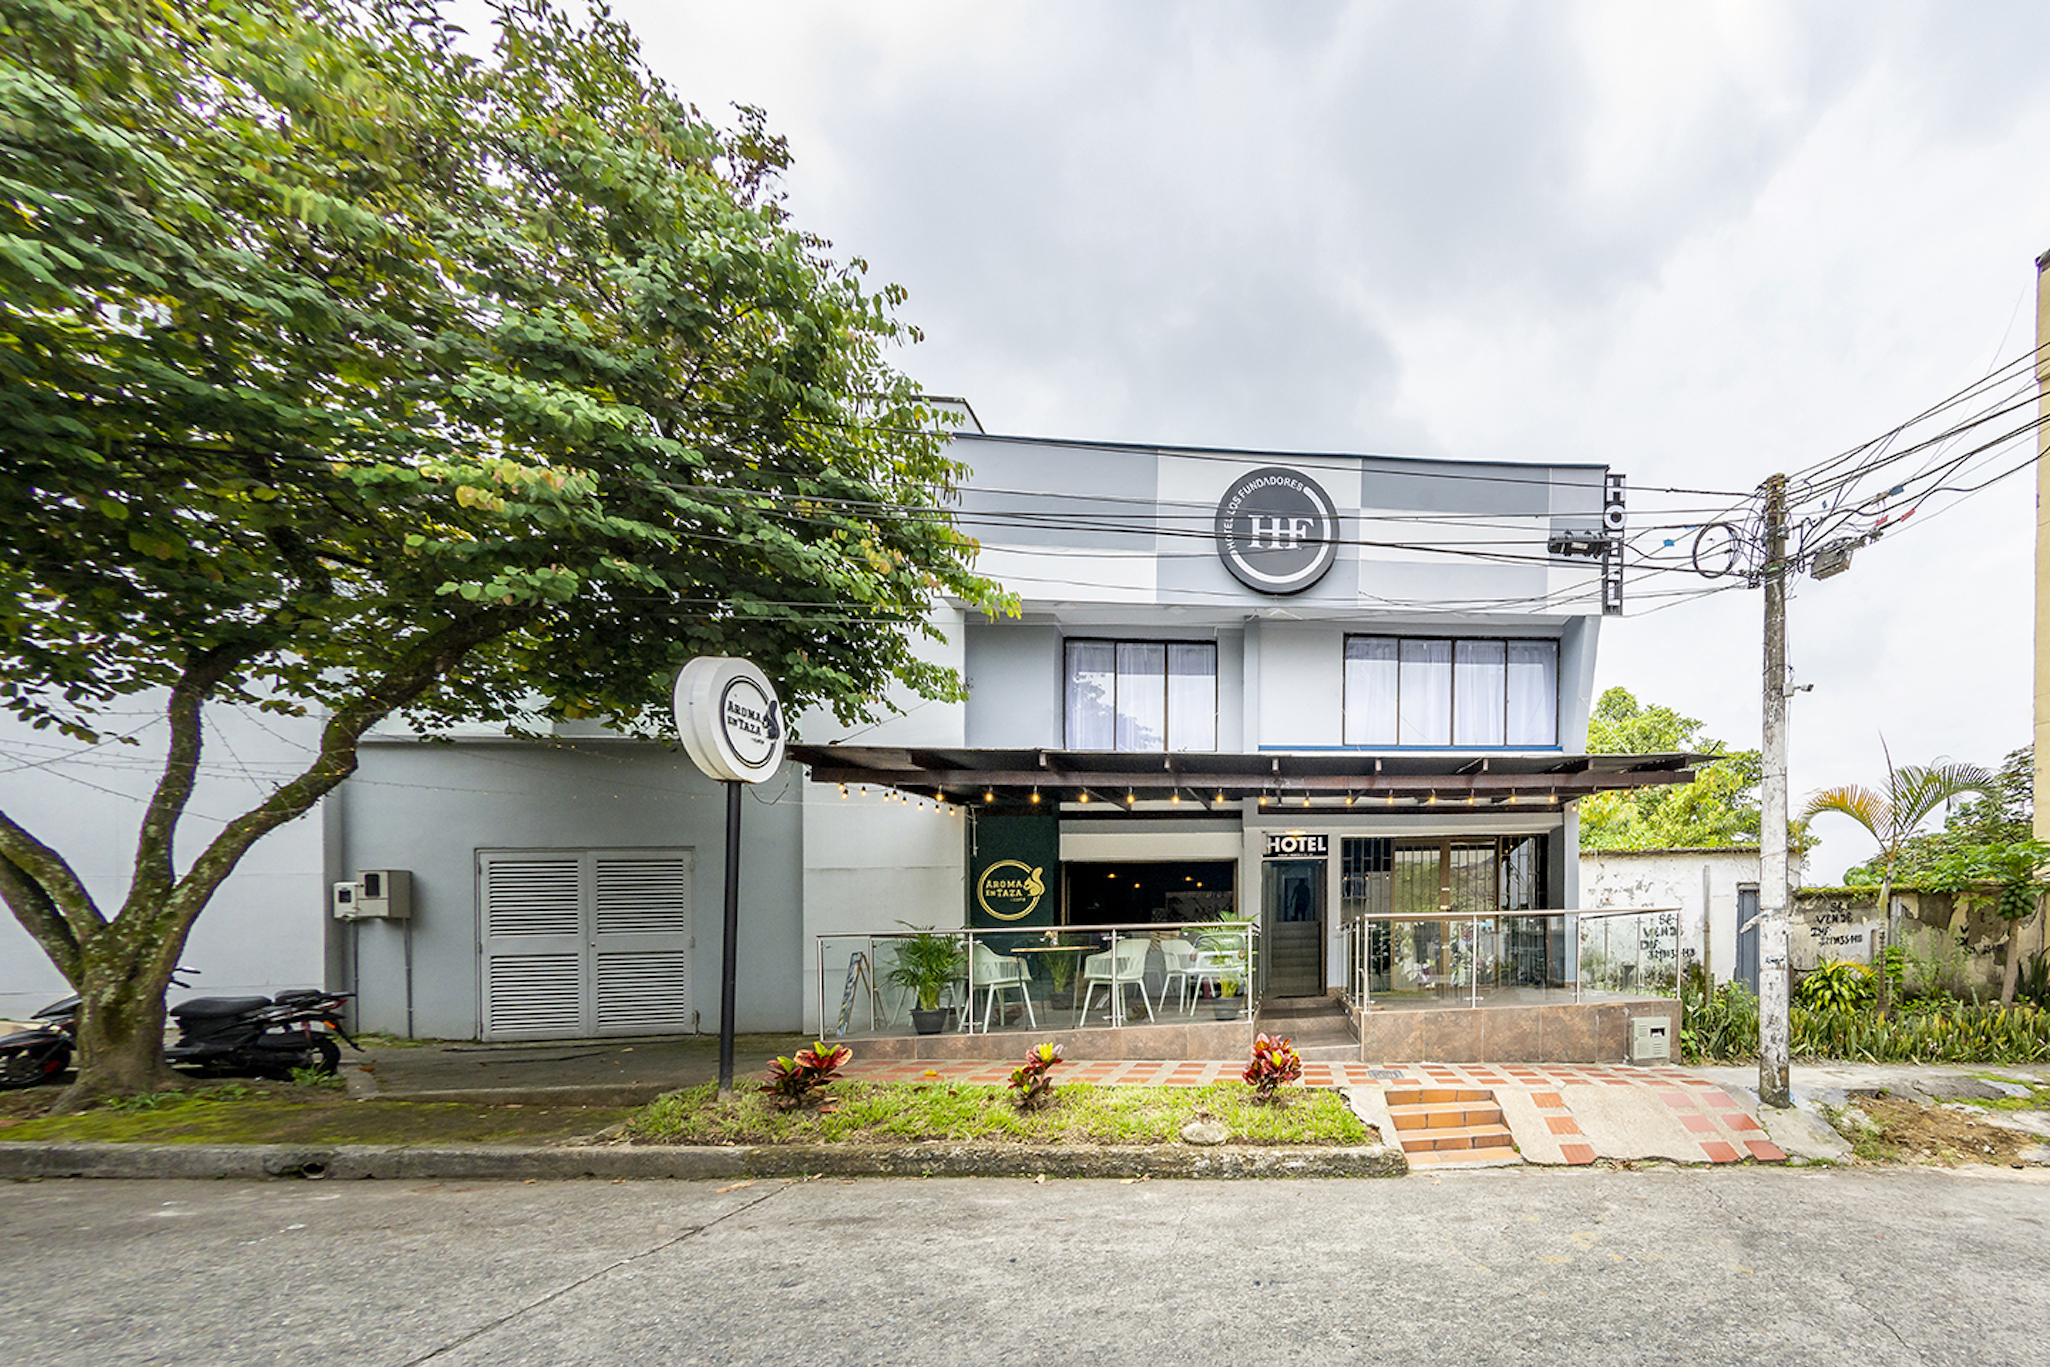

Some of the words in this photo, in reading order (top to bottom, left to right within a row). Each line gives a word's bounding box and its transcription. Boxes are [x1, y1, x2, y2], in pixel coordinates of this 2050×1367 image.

[1237, 476, 1304, 499] FUNDADORES
[1226, 496, 1242, 516] LOS
[1223, 516, 1238, 550] HOTEL
[1247, 514, 1315, 551] HF
[727, 700, 762, 721] AROMA
[738, 718, 762, 736] TAZA
[1267, 836, 1327, 854] HOTEL
[985, 880, 1023, 889] AROMA
[996, 889, 1023, 898] TAZA
[1816, 912, 1853, 924] VENDE
[1643, 926, 1684, 937] VEND
